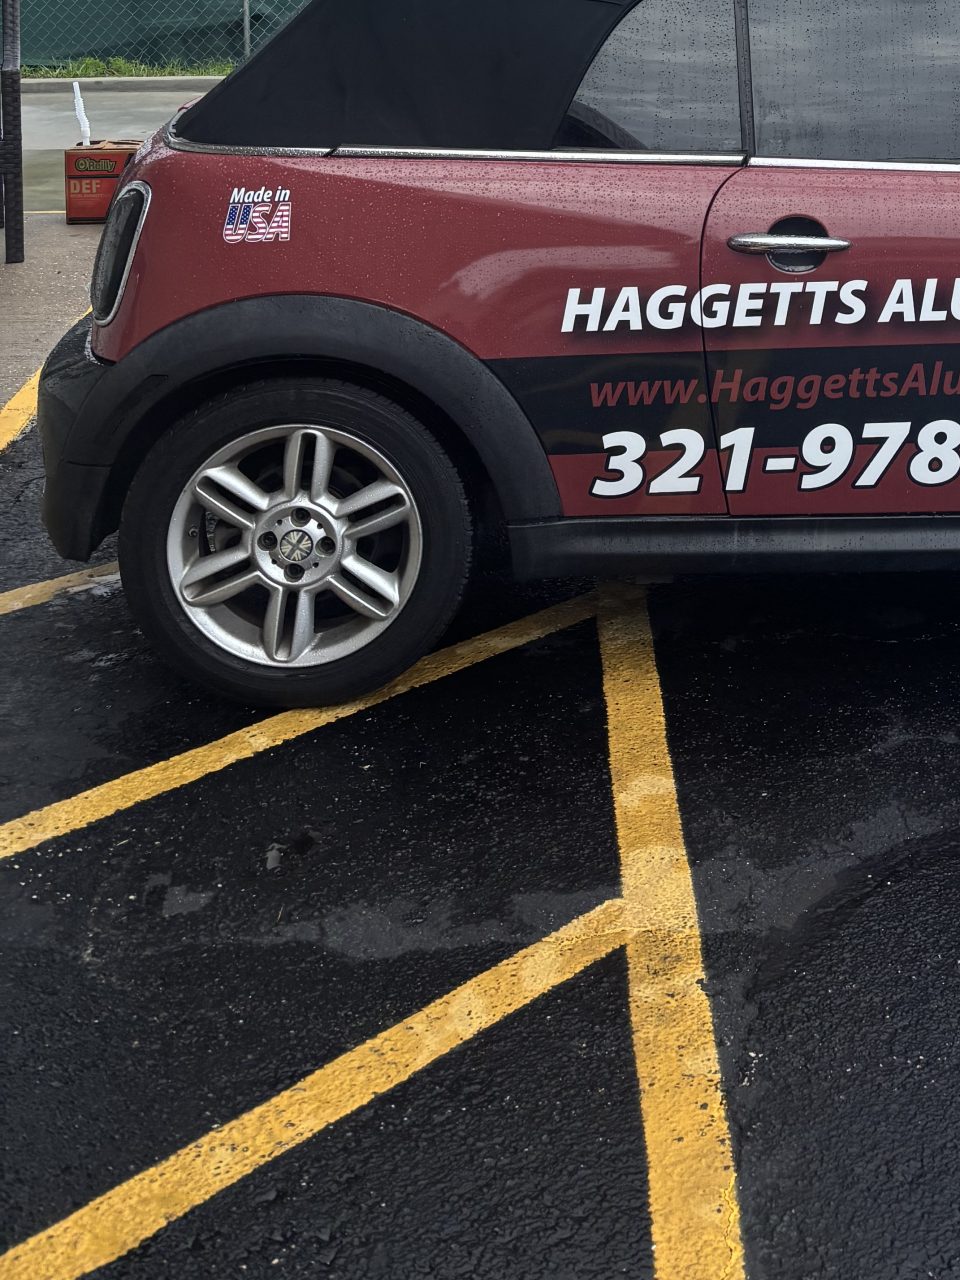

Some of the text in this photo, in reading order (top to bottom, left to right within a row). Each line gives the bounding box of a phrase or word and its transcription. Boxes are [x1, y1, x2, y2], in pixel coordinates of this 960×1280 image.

[70, 180, 101, 194] DEF
[229, 186, 291, 203] Made in
[223, 202, 292, 244] USA
[561, 279, 868, 333] HAGGETTS
